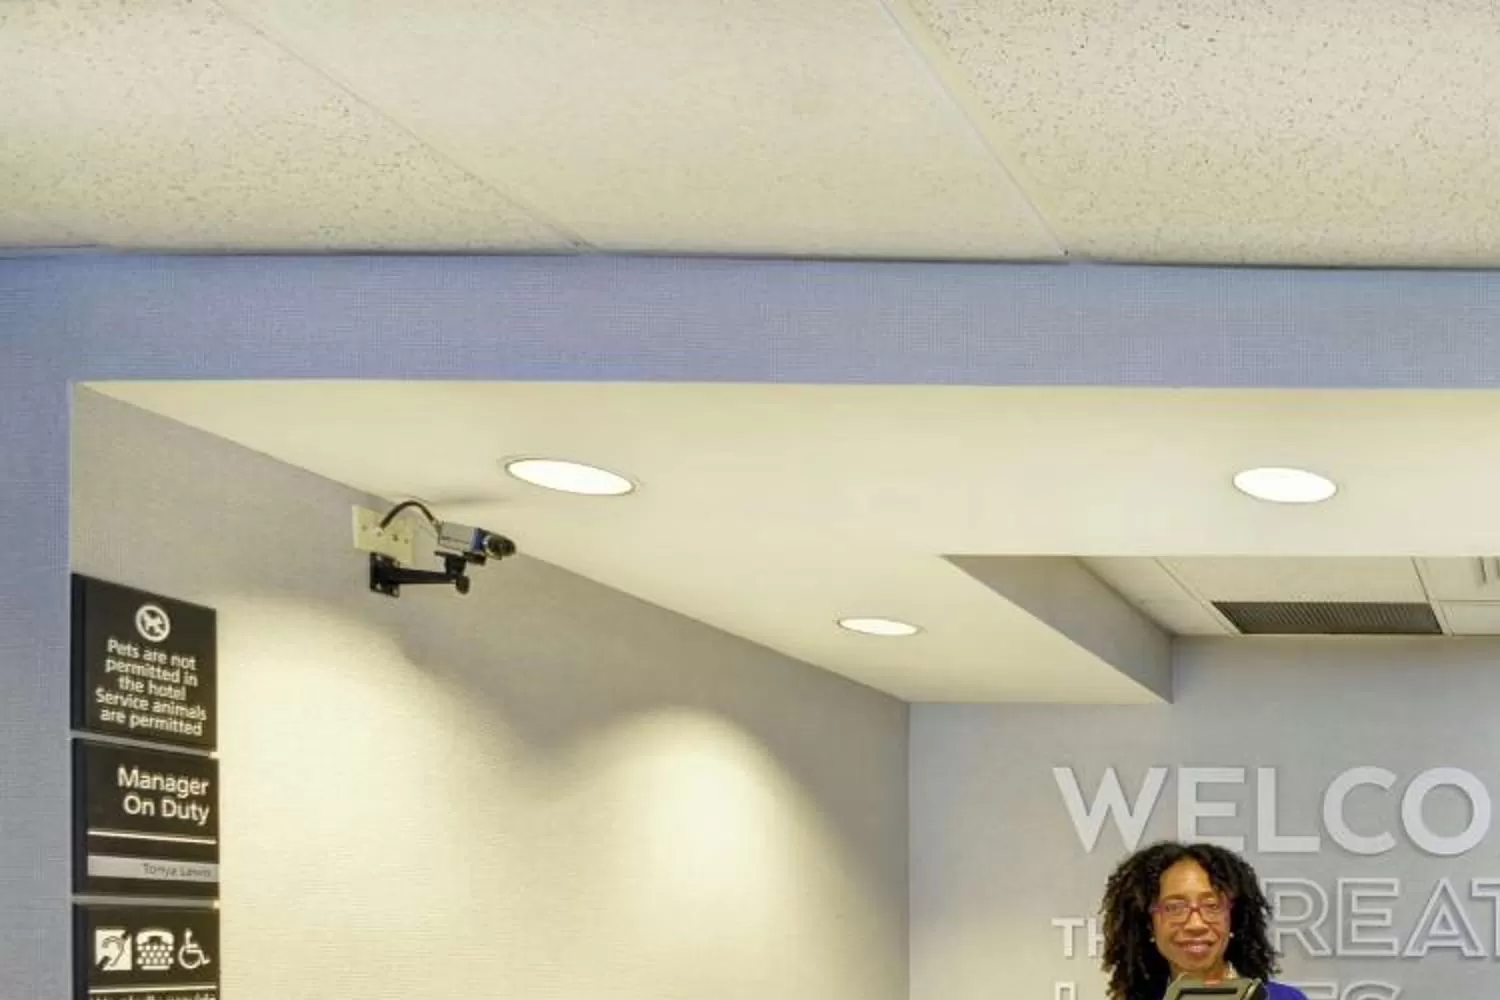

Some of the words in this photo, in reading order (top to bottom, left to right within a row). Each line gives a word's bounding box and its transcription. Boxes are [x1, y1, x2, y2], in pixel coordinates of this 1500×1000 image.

[108, 638, 140, 660] Pets
[143, 649, 167, 665] are
[170, 654, 196, 670] not
[105, 659, 180, 683] permitted
[183, 671, 198, 687] in
[118, 675, 144, 693] the
[149, 680, 187, 701] hotel
[95, 687, 149, 711] Service
[152, 701, 207, 721] animals
[100, 708, 126, 723] are
[129, 713, 203, 736] permitted
[117, 766, 209, 799] Manager
[123, 795, 155, 816] On
[161, 798, 210, 826] Duty
